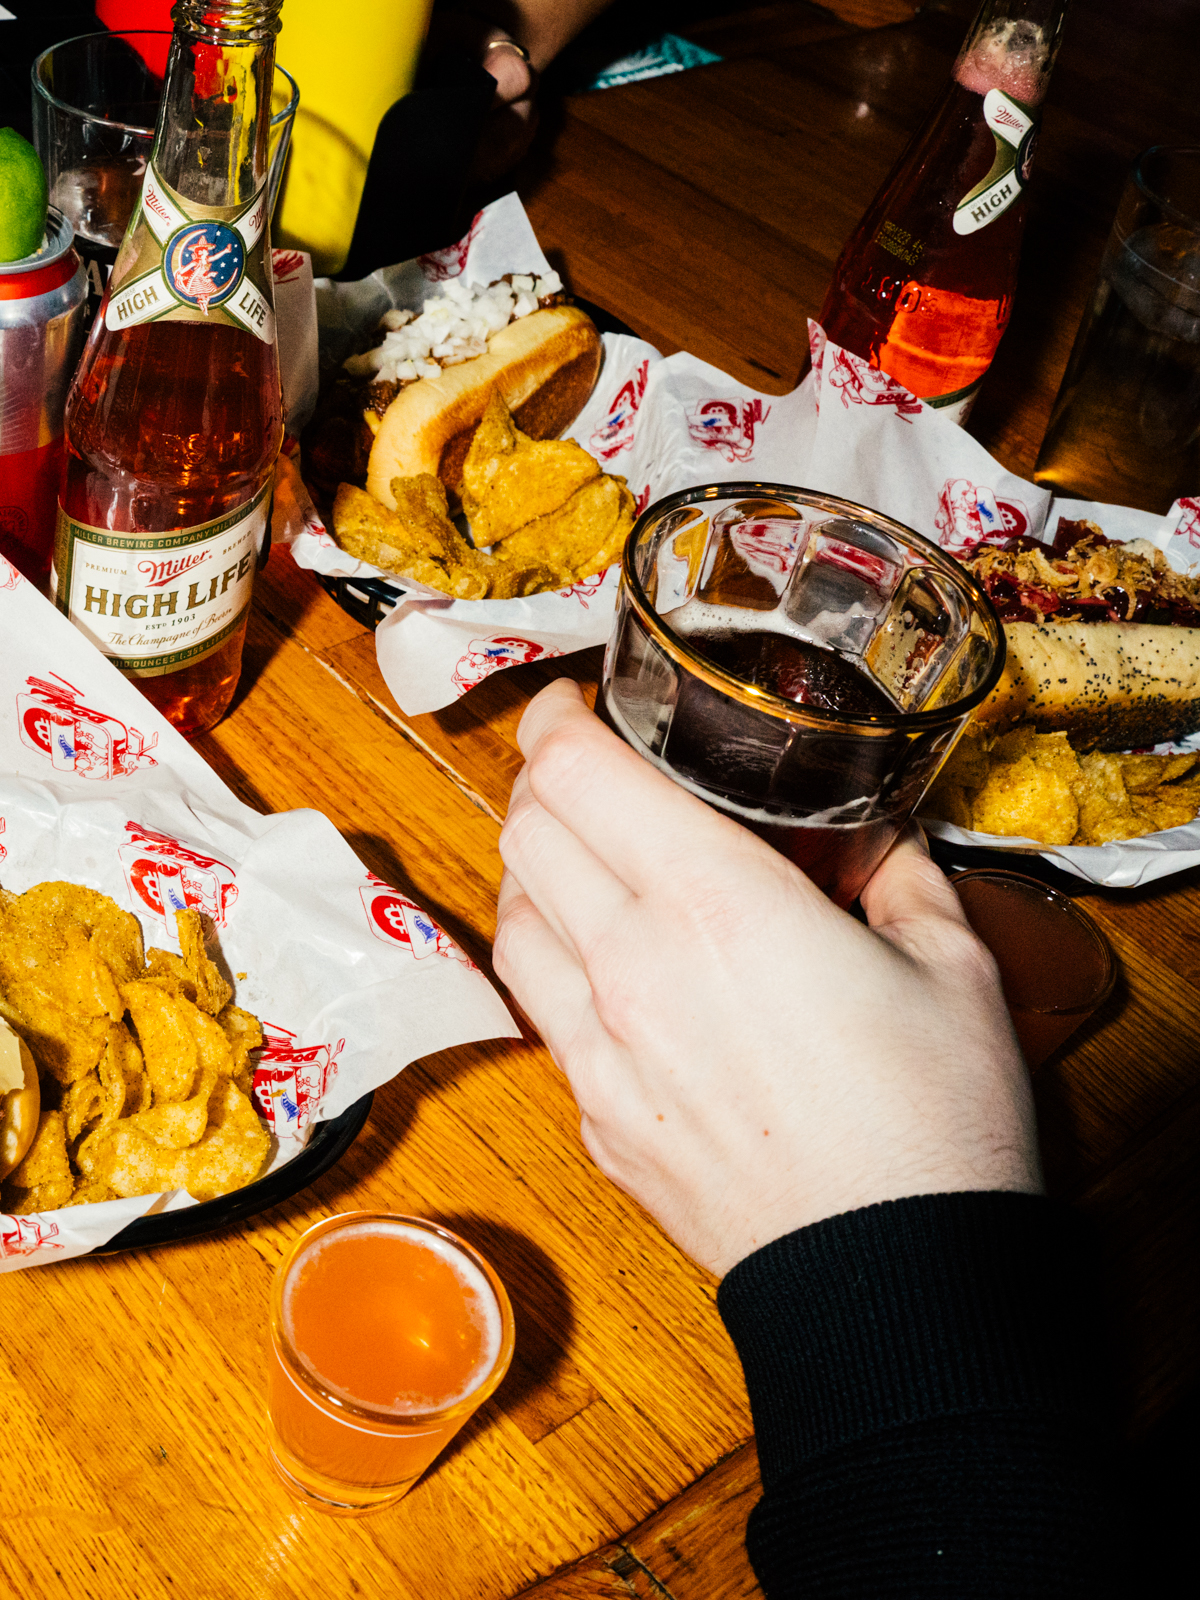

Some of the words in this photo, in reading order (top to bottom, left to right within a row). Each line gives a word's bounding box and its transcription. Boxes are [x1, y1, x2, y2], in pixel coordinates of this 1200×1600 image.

[991, 105, 1024, 132] Miller
[144, 183, 172, 225] Miller
[970, 184, 1013, 223] HIGH
[116, 285, 159, 322] HIGH
[238, 291, 267, 328] LIFE
[74, 528, 103, 544] MILLER
[106, 537, 154, 548] BREWING
[157, 531, 210, 548] COMPANY
[84, 584, 179, 619] HIGH
[186, 549, 252, 610] LIFE
[85, 562, 128, 575] PREMIUM
[137, 549, 213, 588] Miller
[104, 632, 127, 646] The
[128, 631, 191, 648] Champagne
[191, 619, 205, 639] of
[171, 613, 196, 626] 1903
[133, 655, 176, 668] OUNCES
